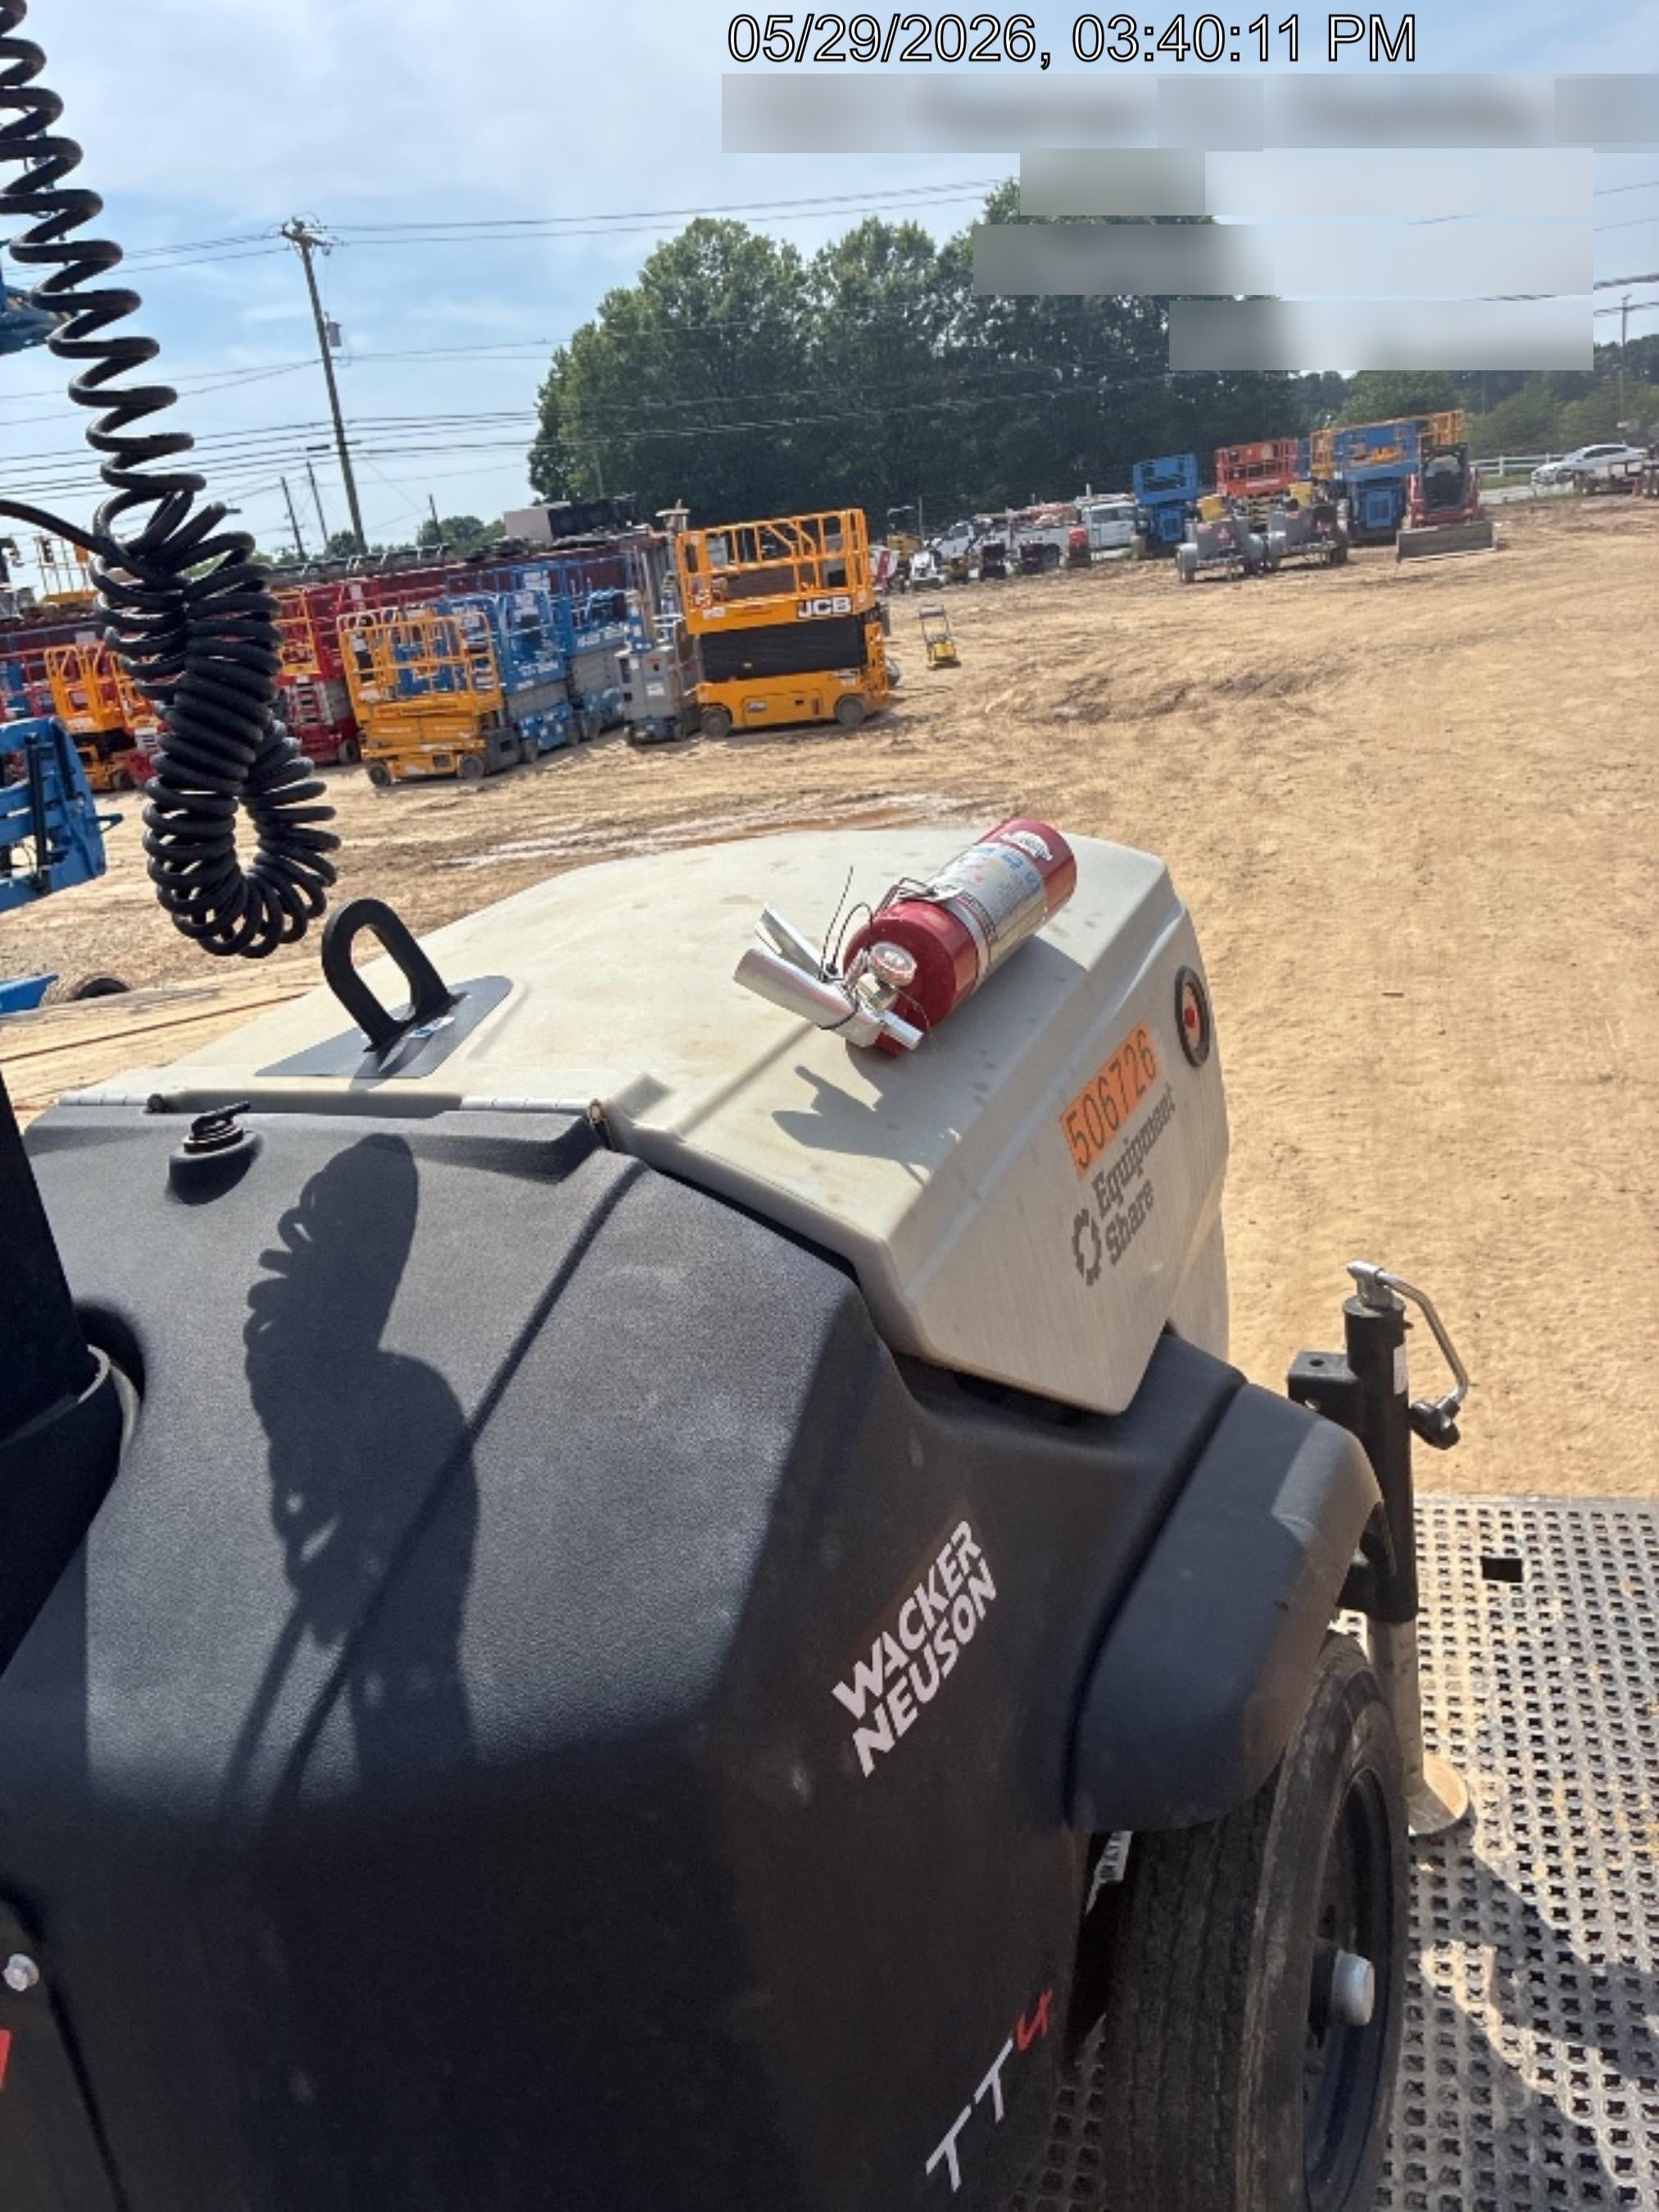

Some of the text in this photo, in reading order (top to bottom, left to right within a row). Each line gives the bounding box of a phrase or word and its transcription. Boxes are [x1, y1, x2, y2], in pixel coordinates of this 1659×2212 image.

[797, 596, 852, 619] JCB
[1066, 1028, 1156, 1172] 506726
[1092, 1081, 1176, 1220] Equipment
[1106, 1179, 1154, 1266] Share
[831, 1520, 982, 1720] WACKER
[851, 1557, 997, 1778] NEUSON
